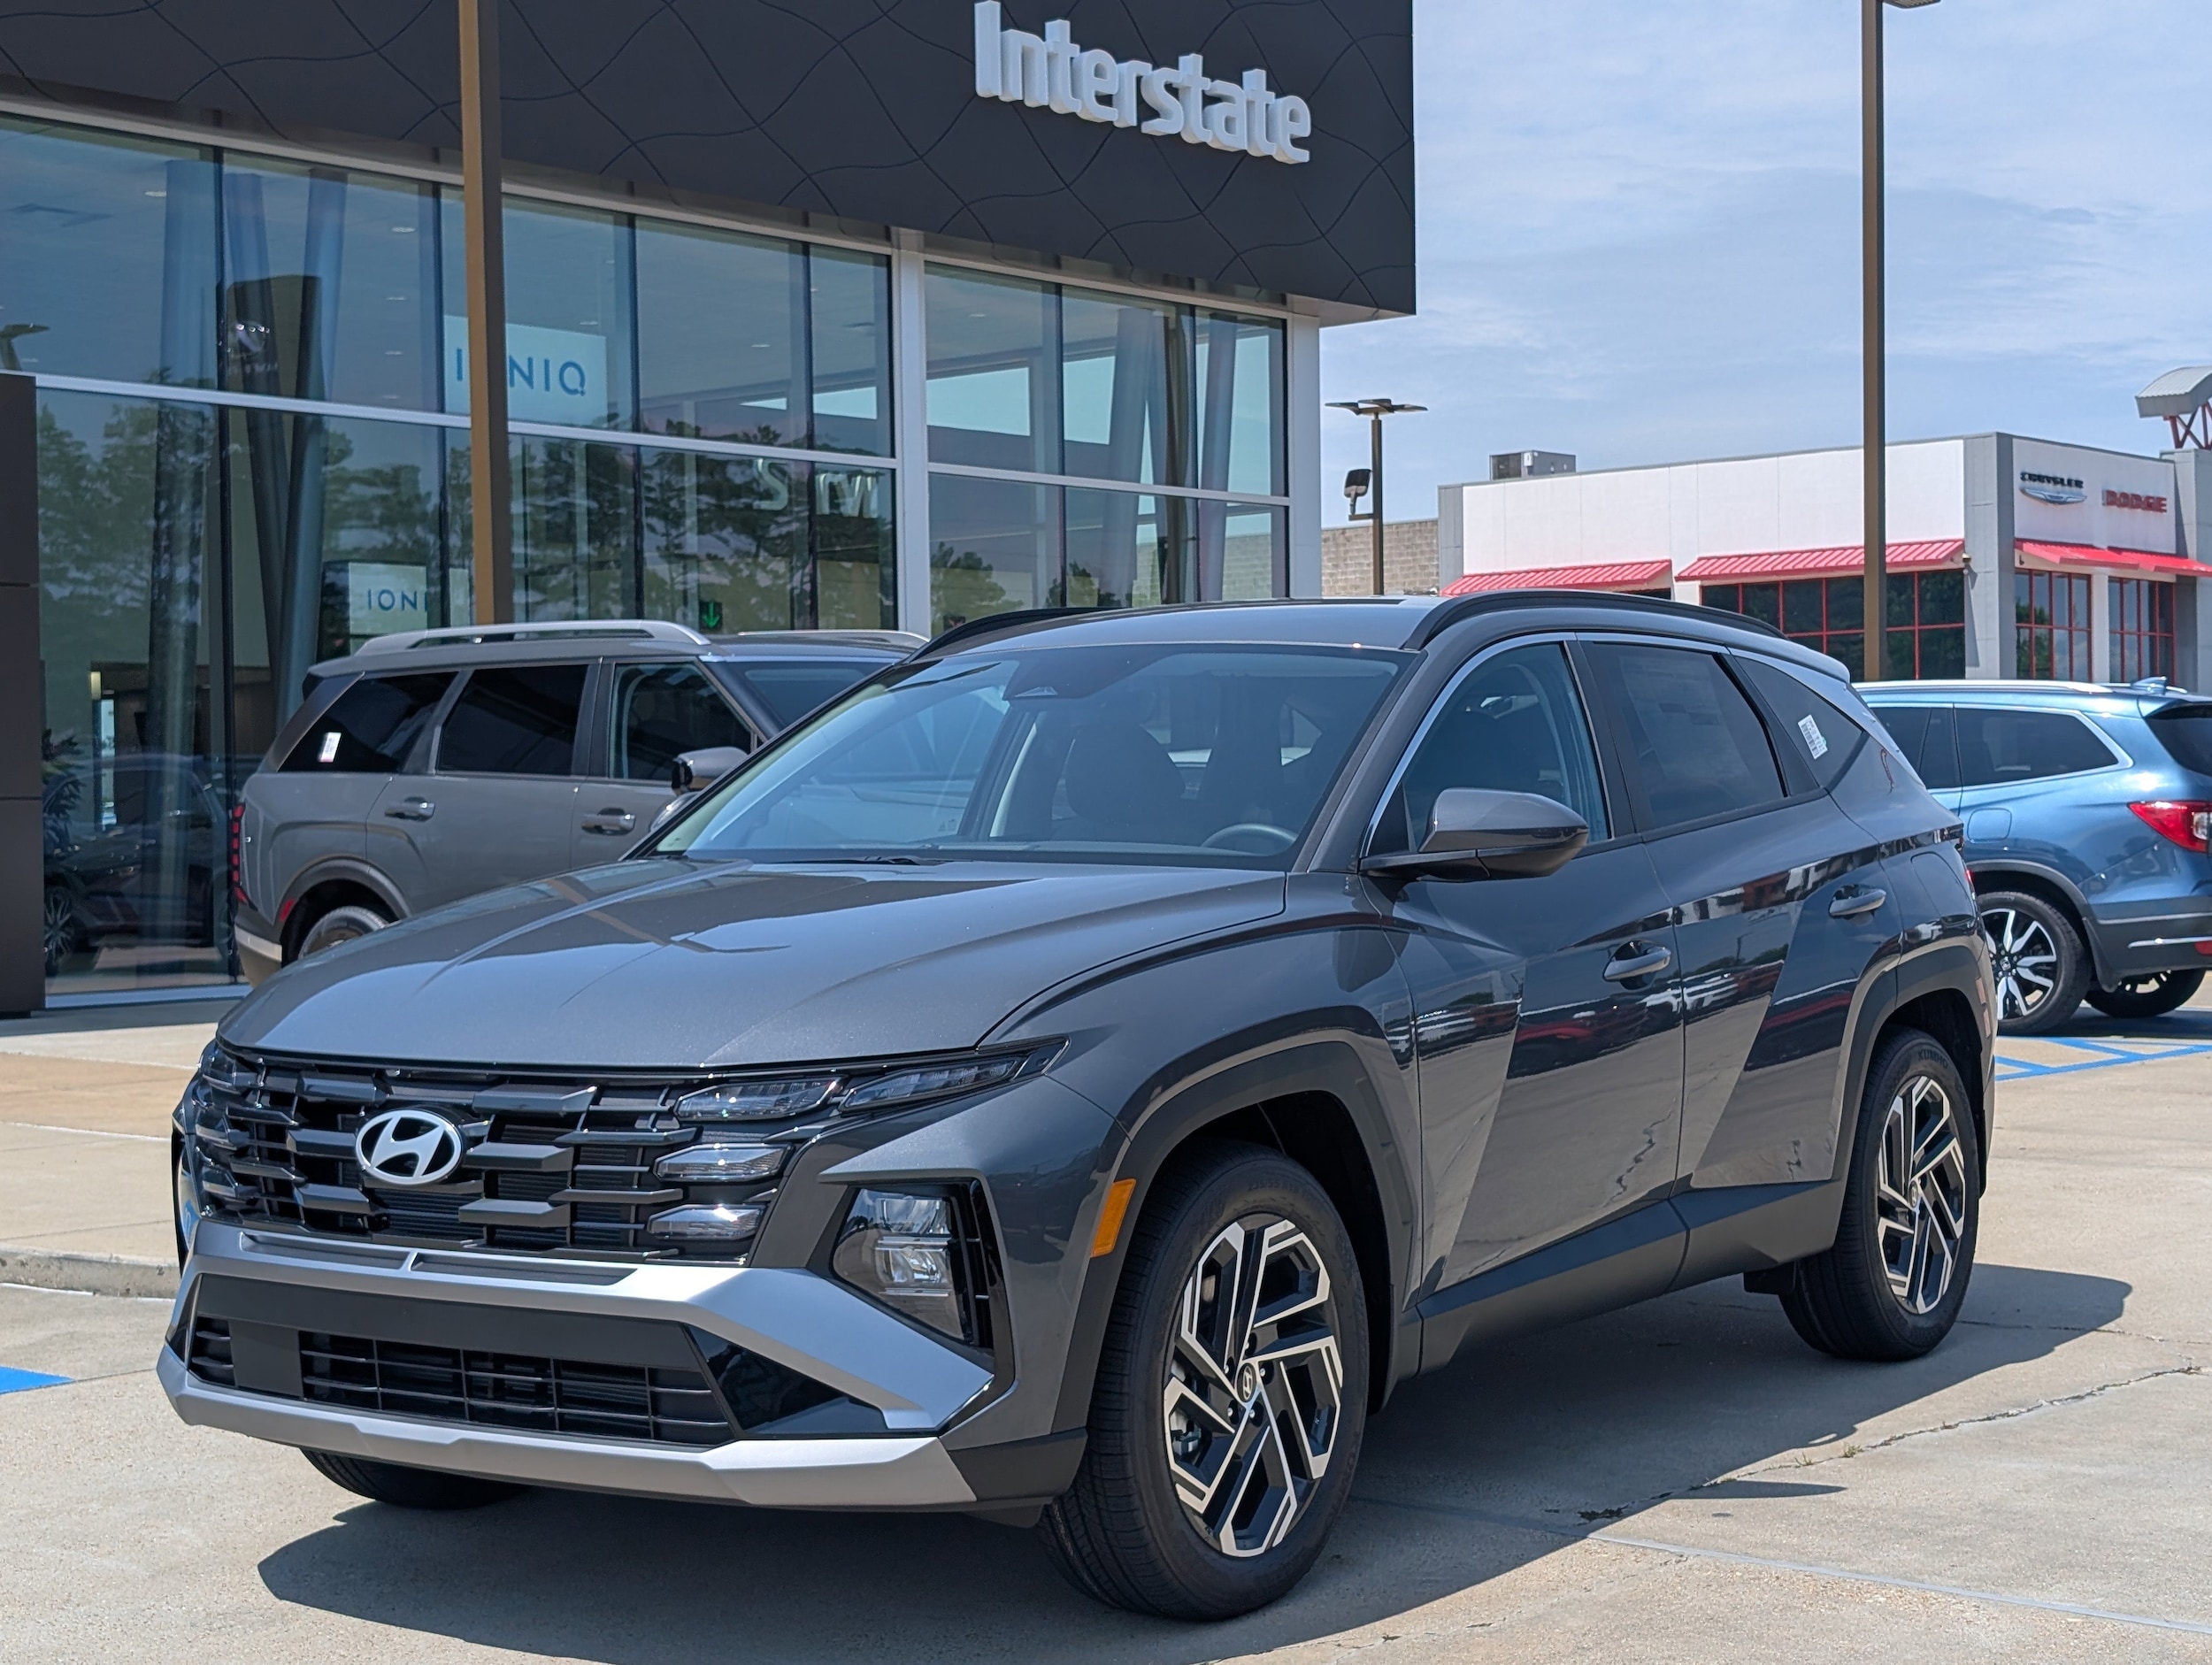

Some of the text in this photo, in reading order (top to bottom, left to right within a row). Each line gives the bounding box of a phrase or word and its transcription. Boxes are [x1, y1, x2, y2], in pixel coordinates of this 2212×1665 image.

[974, 0, 1311, 165] Interstate
[456, 347, 586, 397] INIQ
[2103, 488, 2168, 513] DODGE
